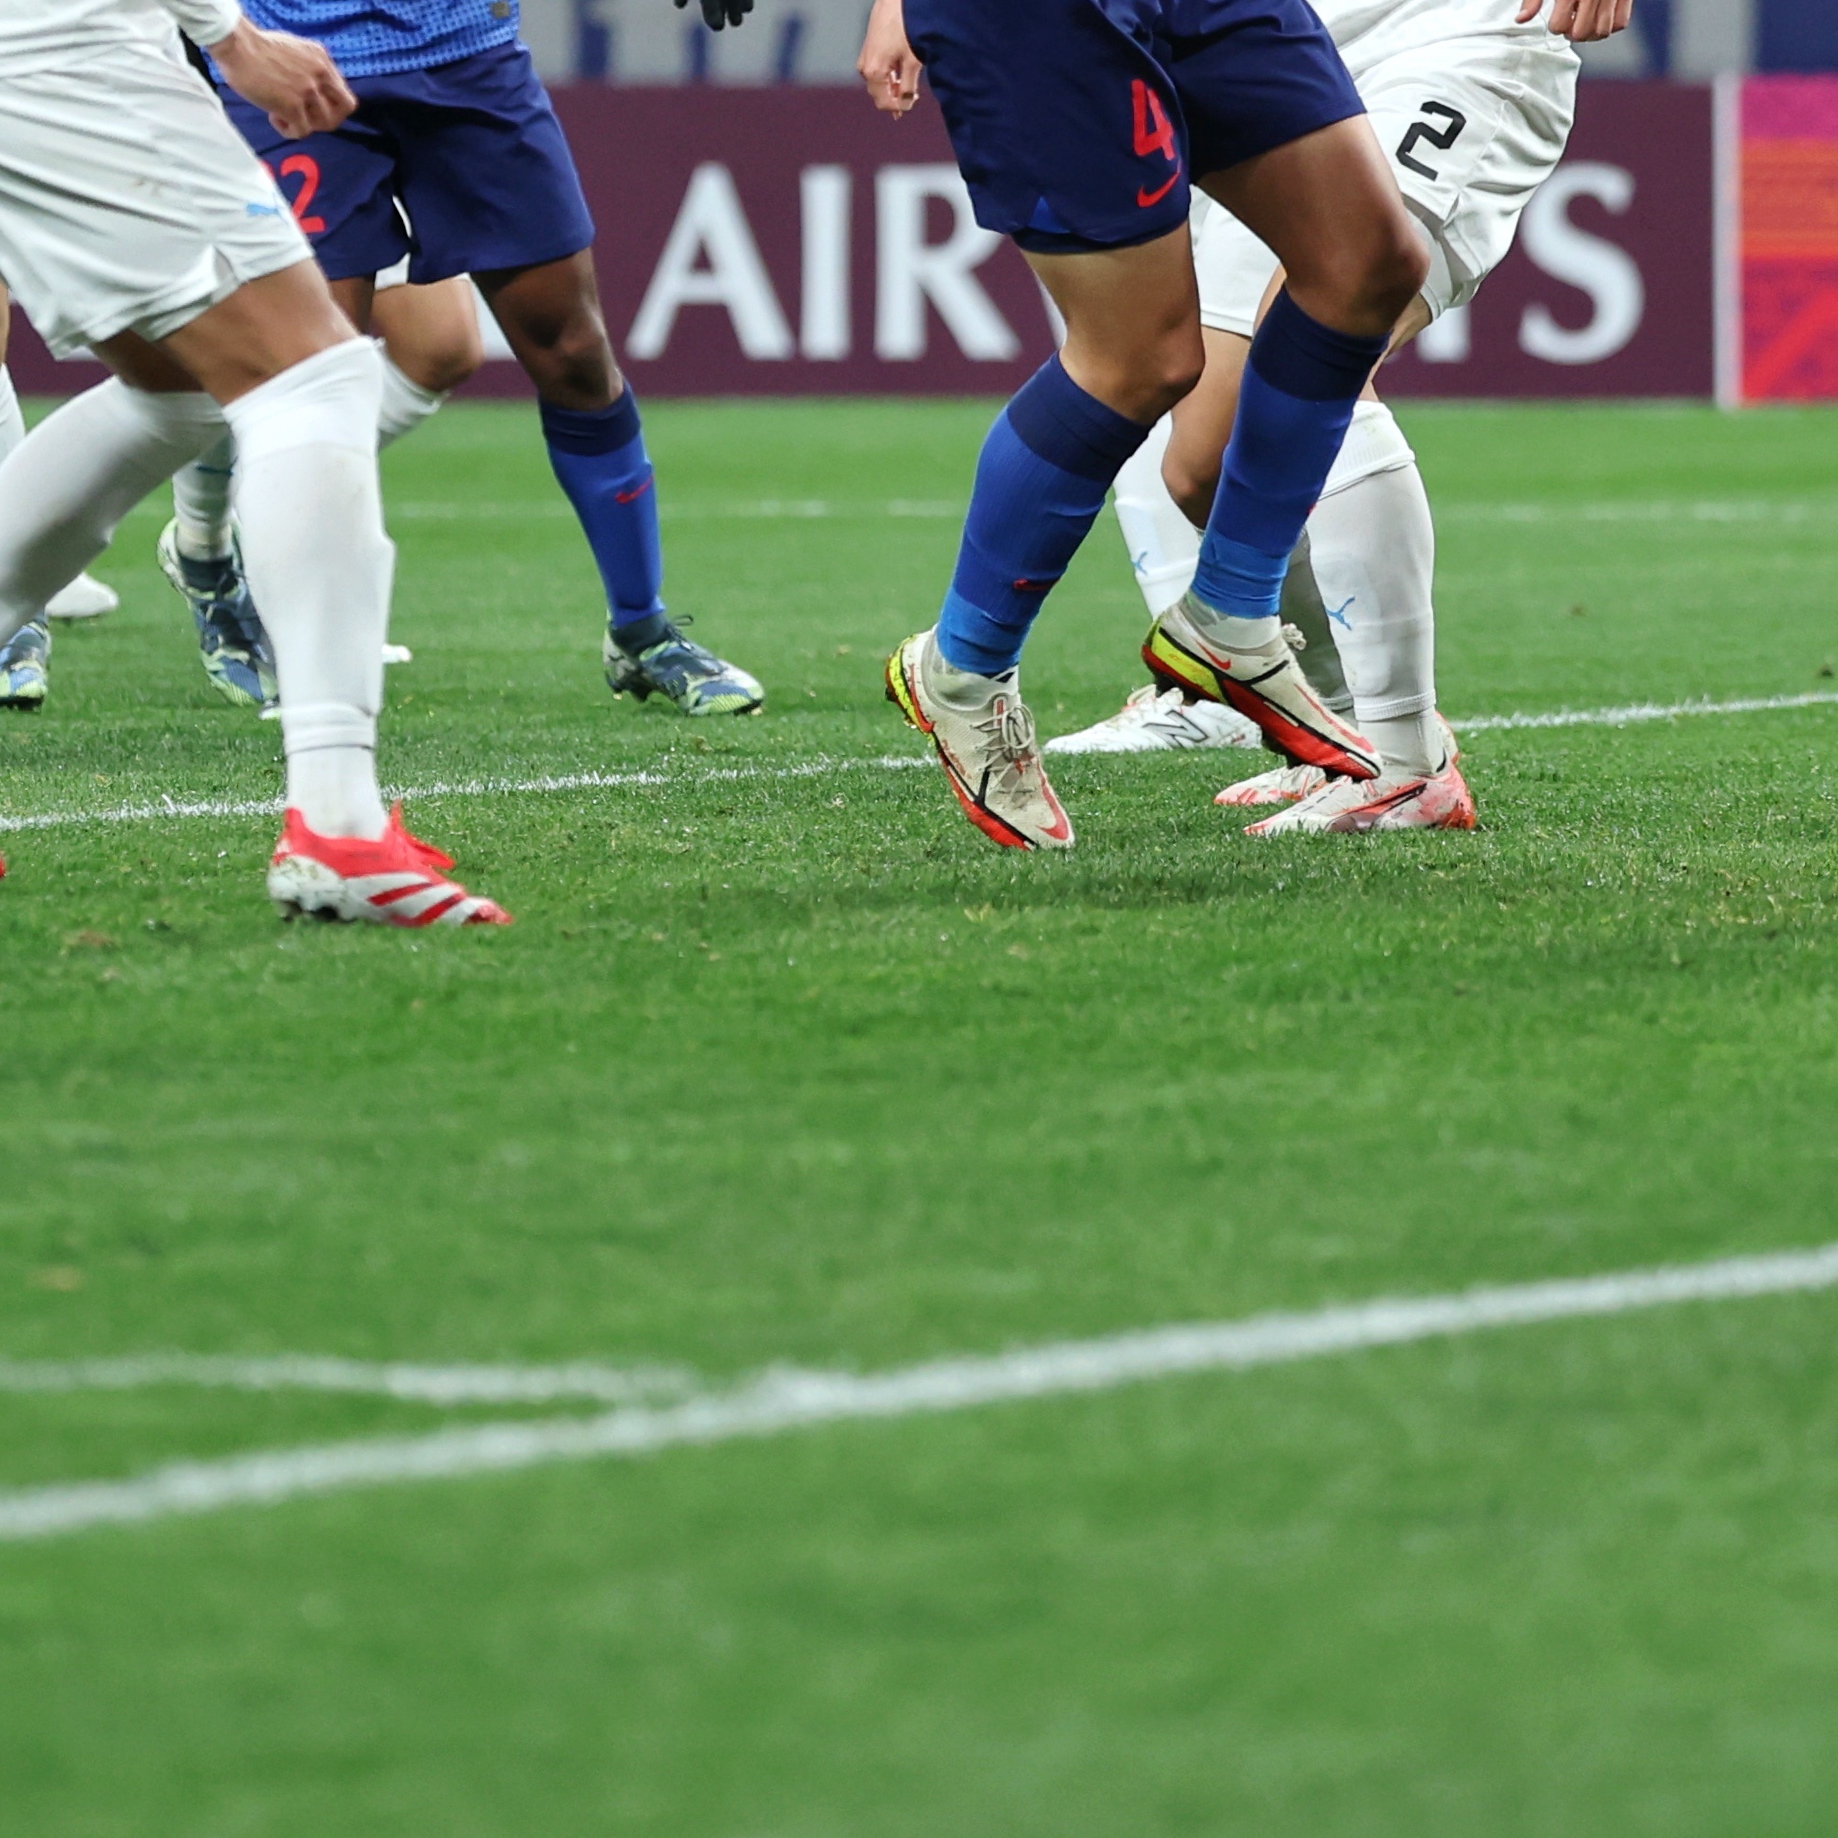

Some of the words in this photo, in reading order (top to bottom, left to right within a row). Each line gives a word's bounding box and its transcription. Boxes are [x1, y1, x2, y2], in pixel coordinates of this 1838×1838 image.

[1128, 78, 1177, 162] 4
[1395, 100, 1466, 180] 2
[262, 154, 326, 233] 2
